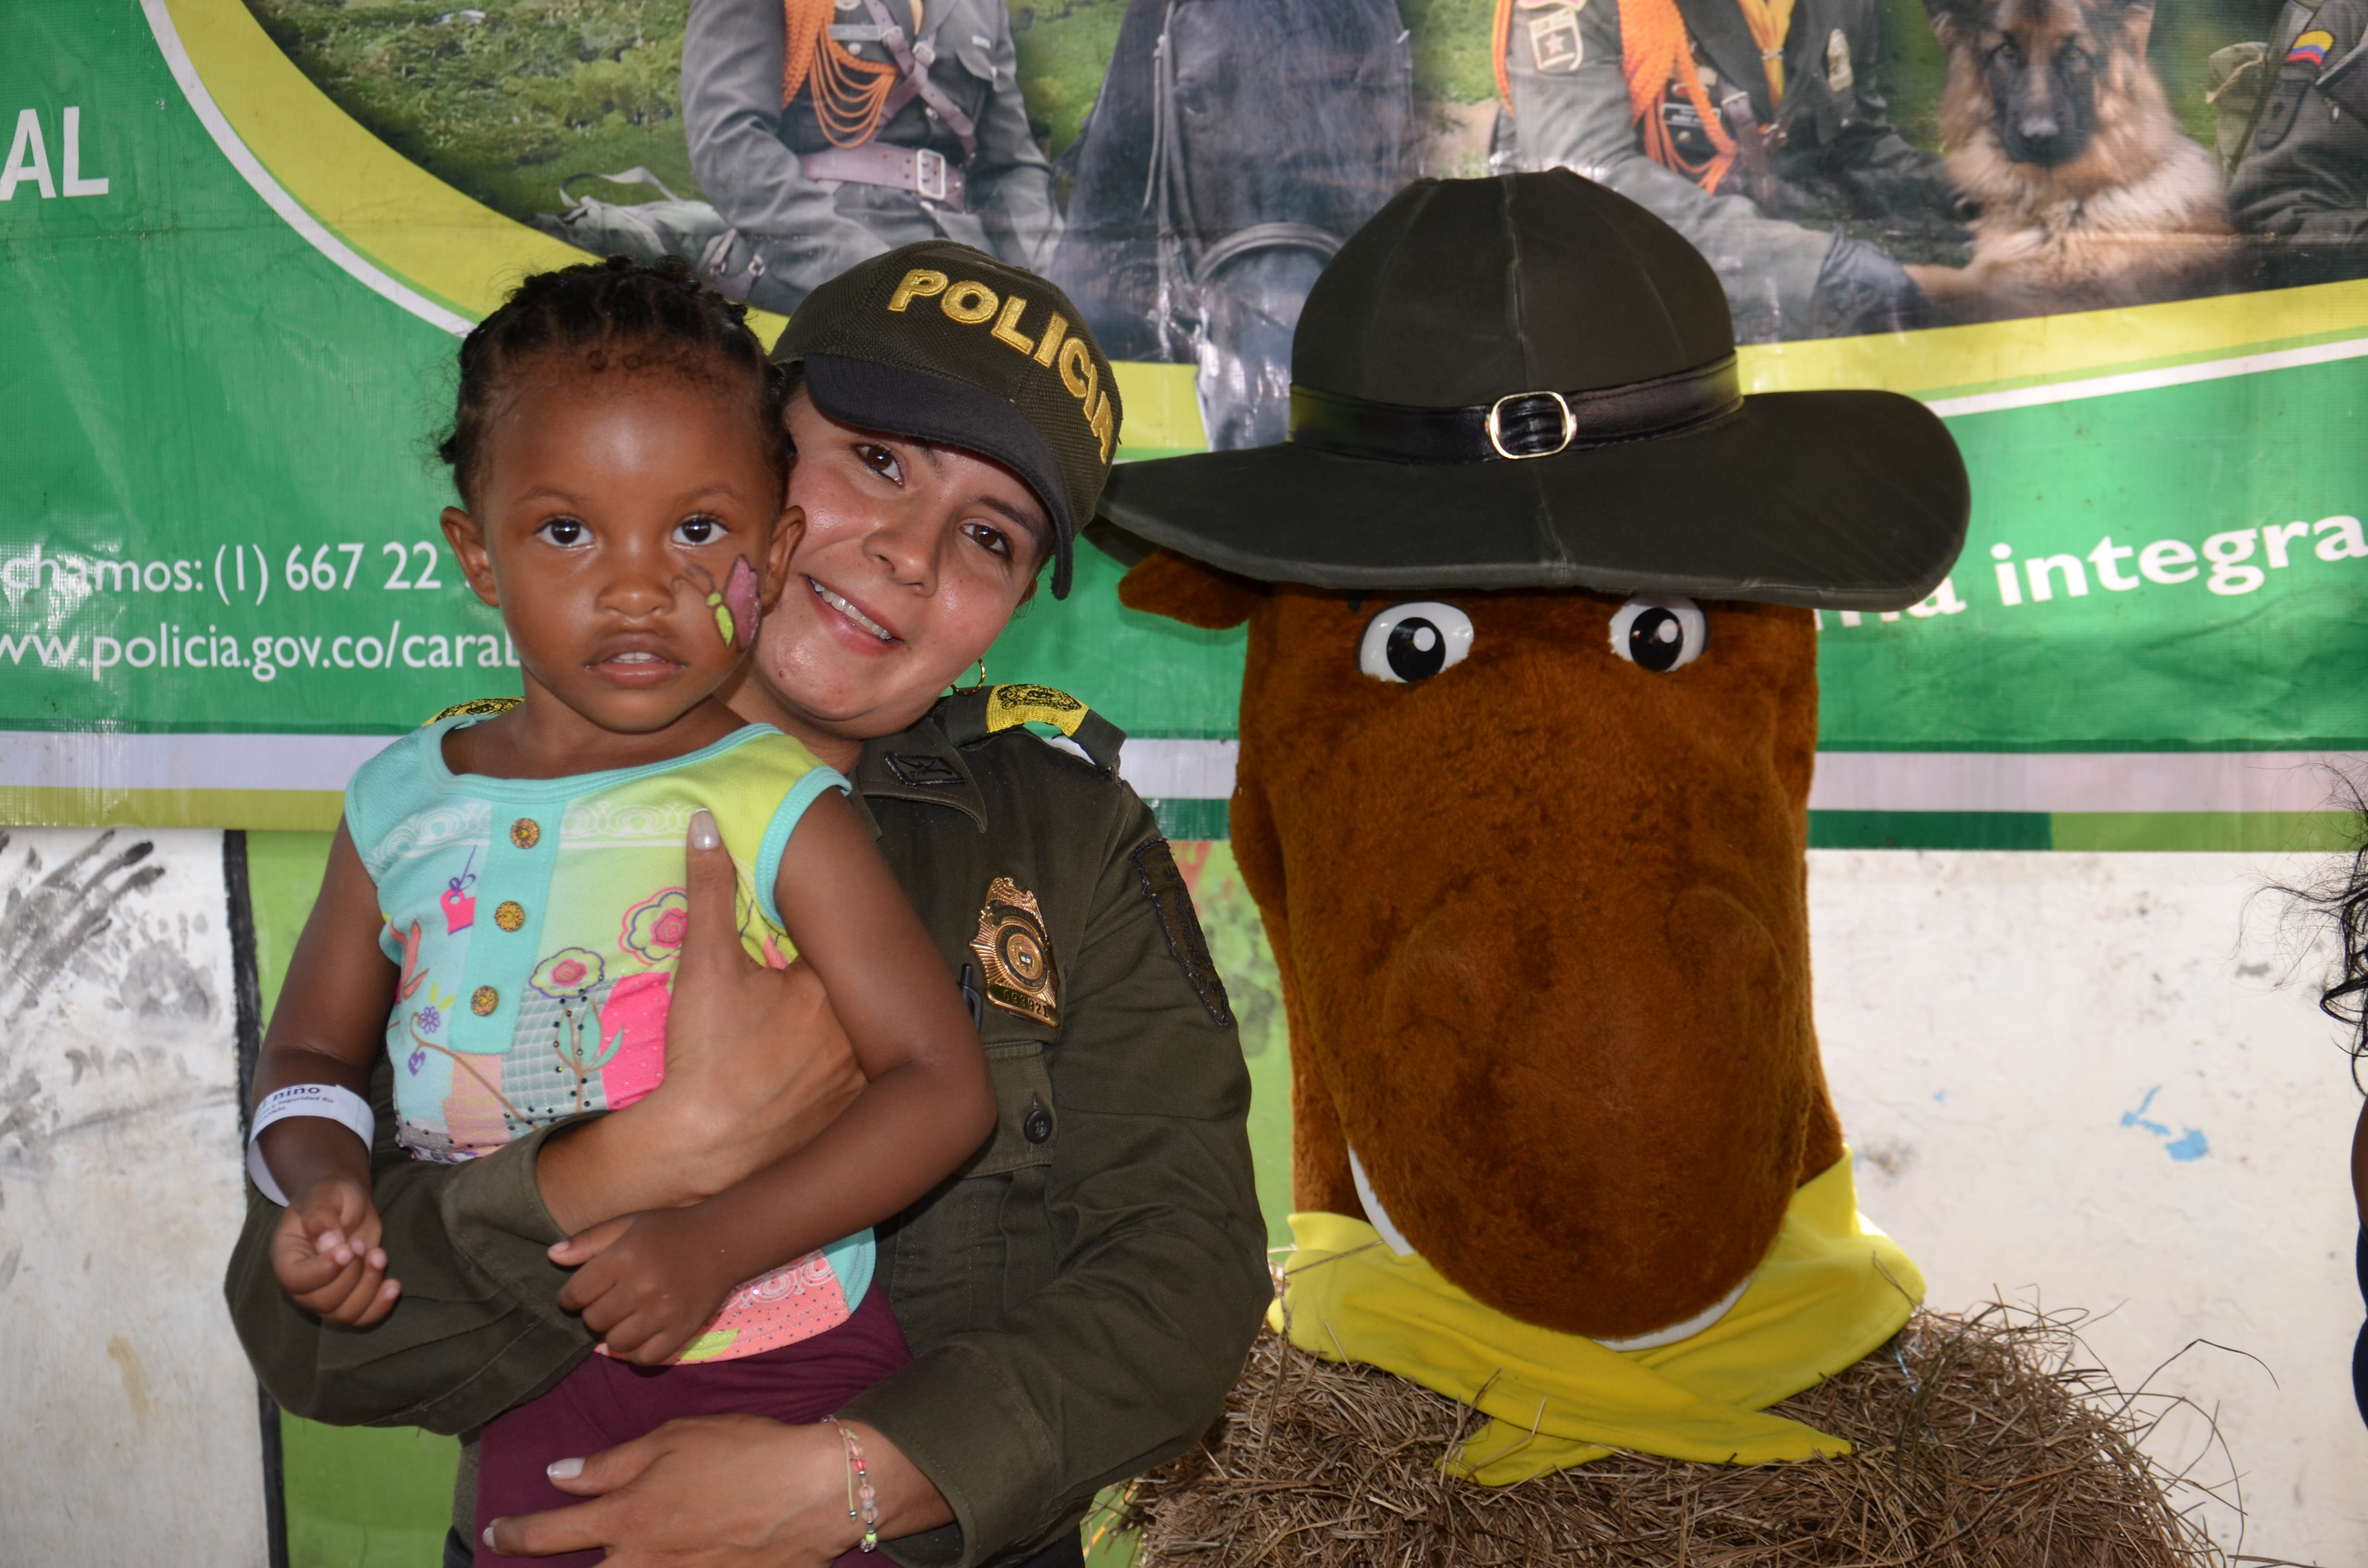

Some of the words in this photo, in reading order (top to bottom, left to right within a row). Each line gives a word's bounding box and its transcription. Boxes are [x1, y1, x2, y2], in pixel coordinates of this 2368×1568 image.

[0, 106, 109, 201] AL
[887, 269, 1113, 465] POLICIA
[2, 544, 204, 593] chamos:
[285, 542, 364, 591] 667
[383, 541, 441, 590] 22
[1991, 514, 2368, 606] integra
[273, 1086, 321, 1101] niño
